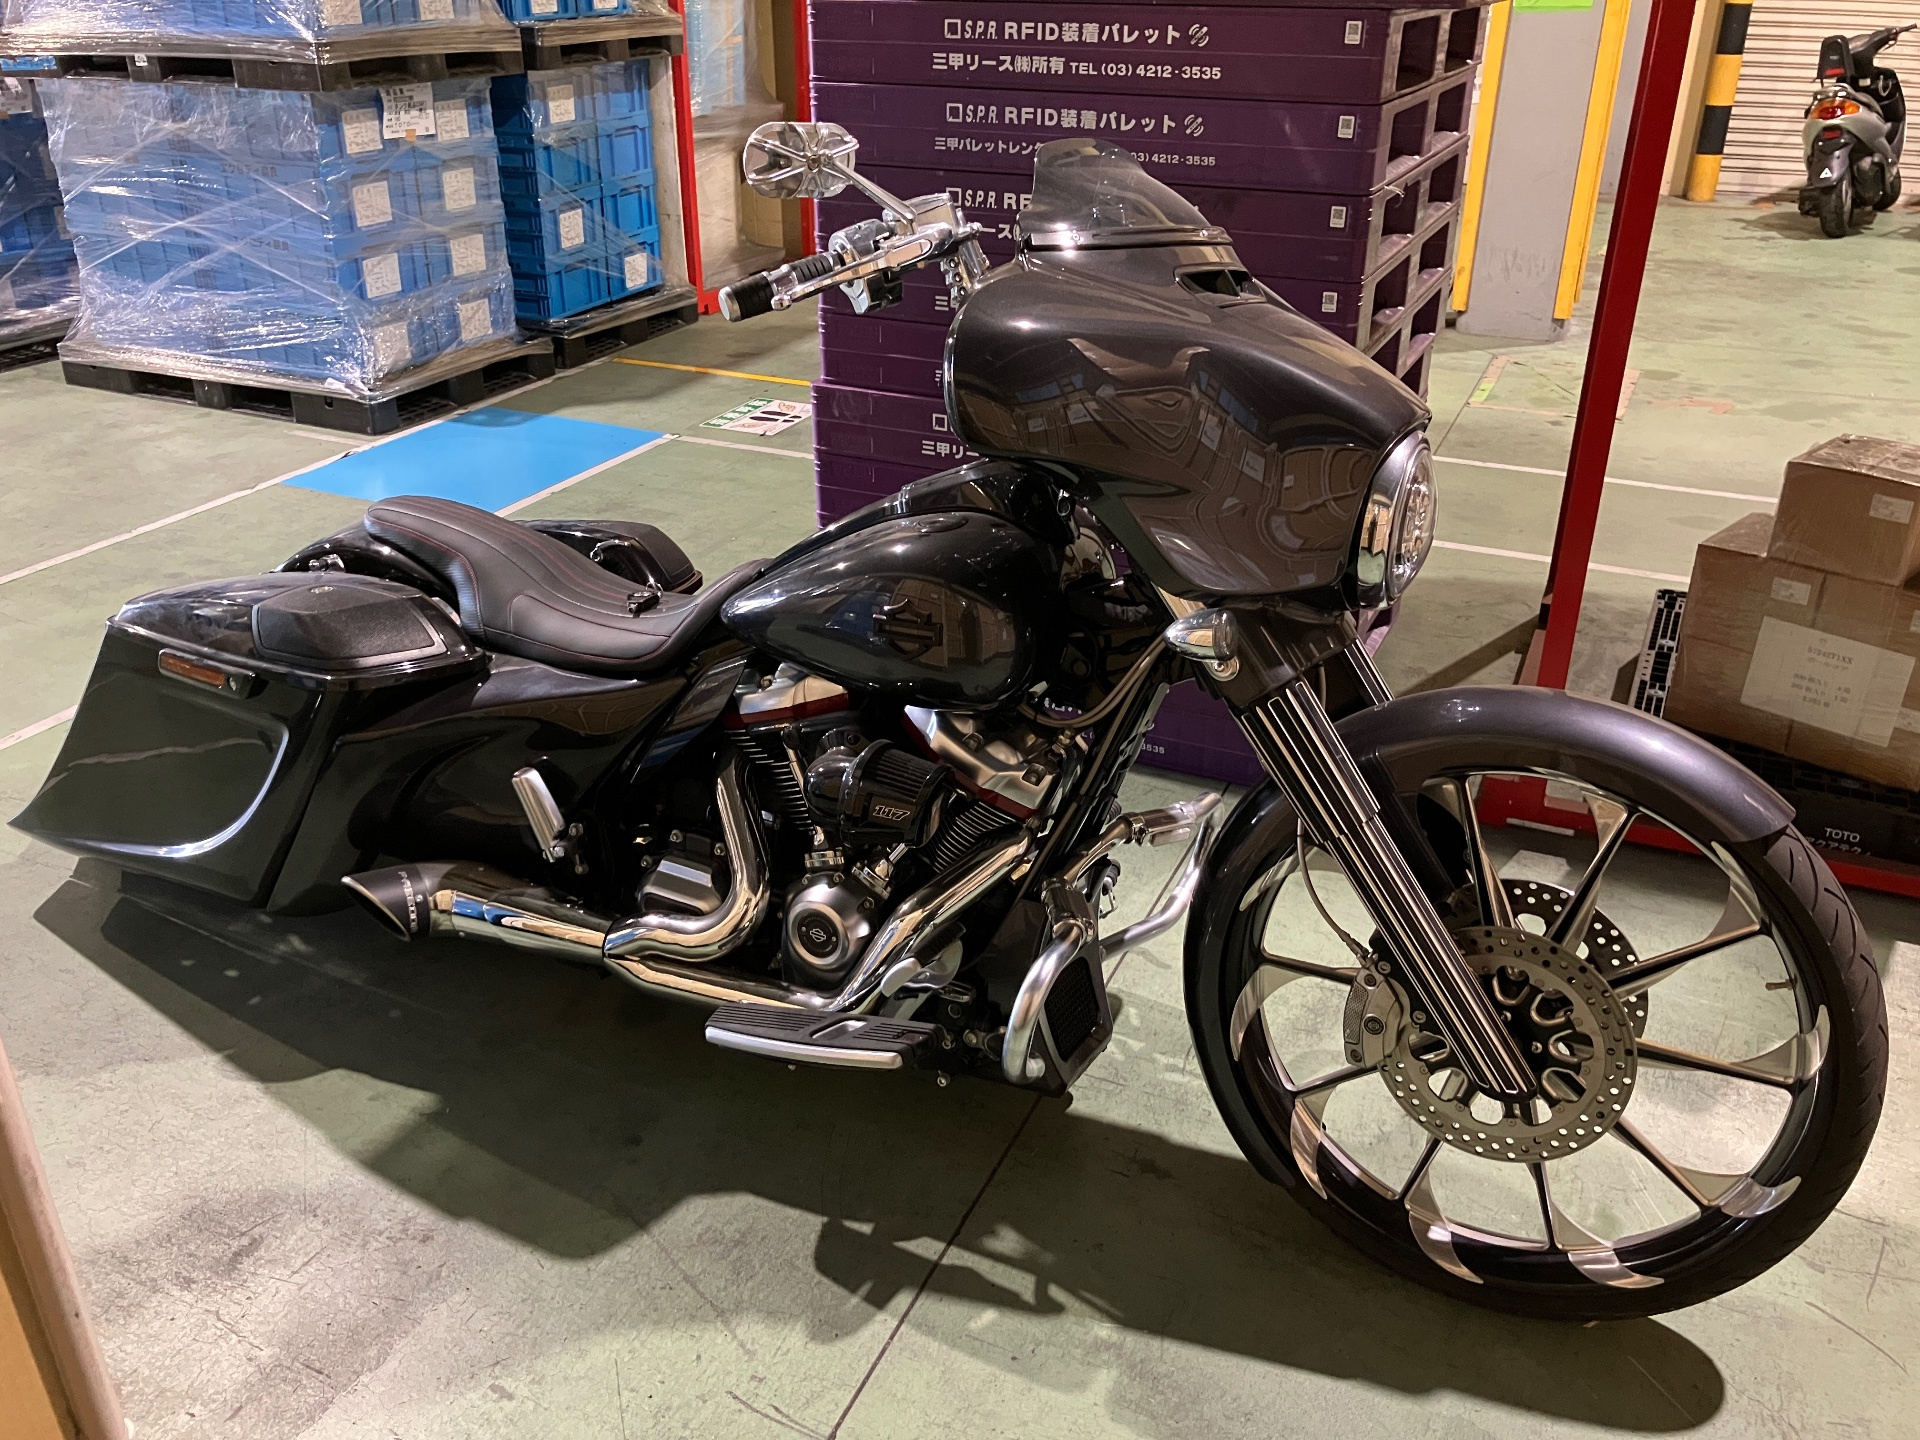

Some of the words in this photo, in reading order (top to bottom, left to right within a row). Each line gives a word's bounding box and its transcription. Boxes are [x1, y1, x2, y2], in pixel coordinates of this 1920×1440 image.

[1004, 21, 1181, 45] RFID装着パレット
[1069, 62, 1098, 75] TEL
[1004, 106, 1176, 134] RFID装着パレット
[872, 804, 911, 821] 117
[1824, 827, 1860, 843] TOTO
